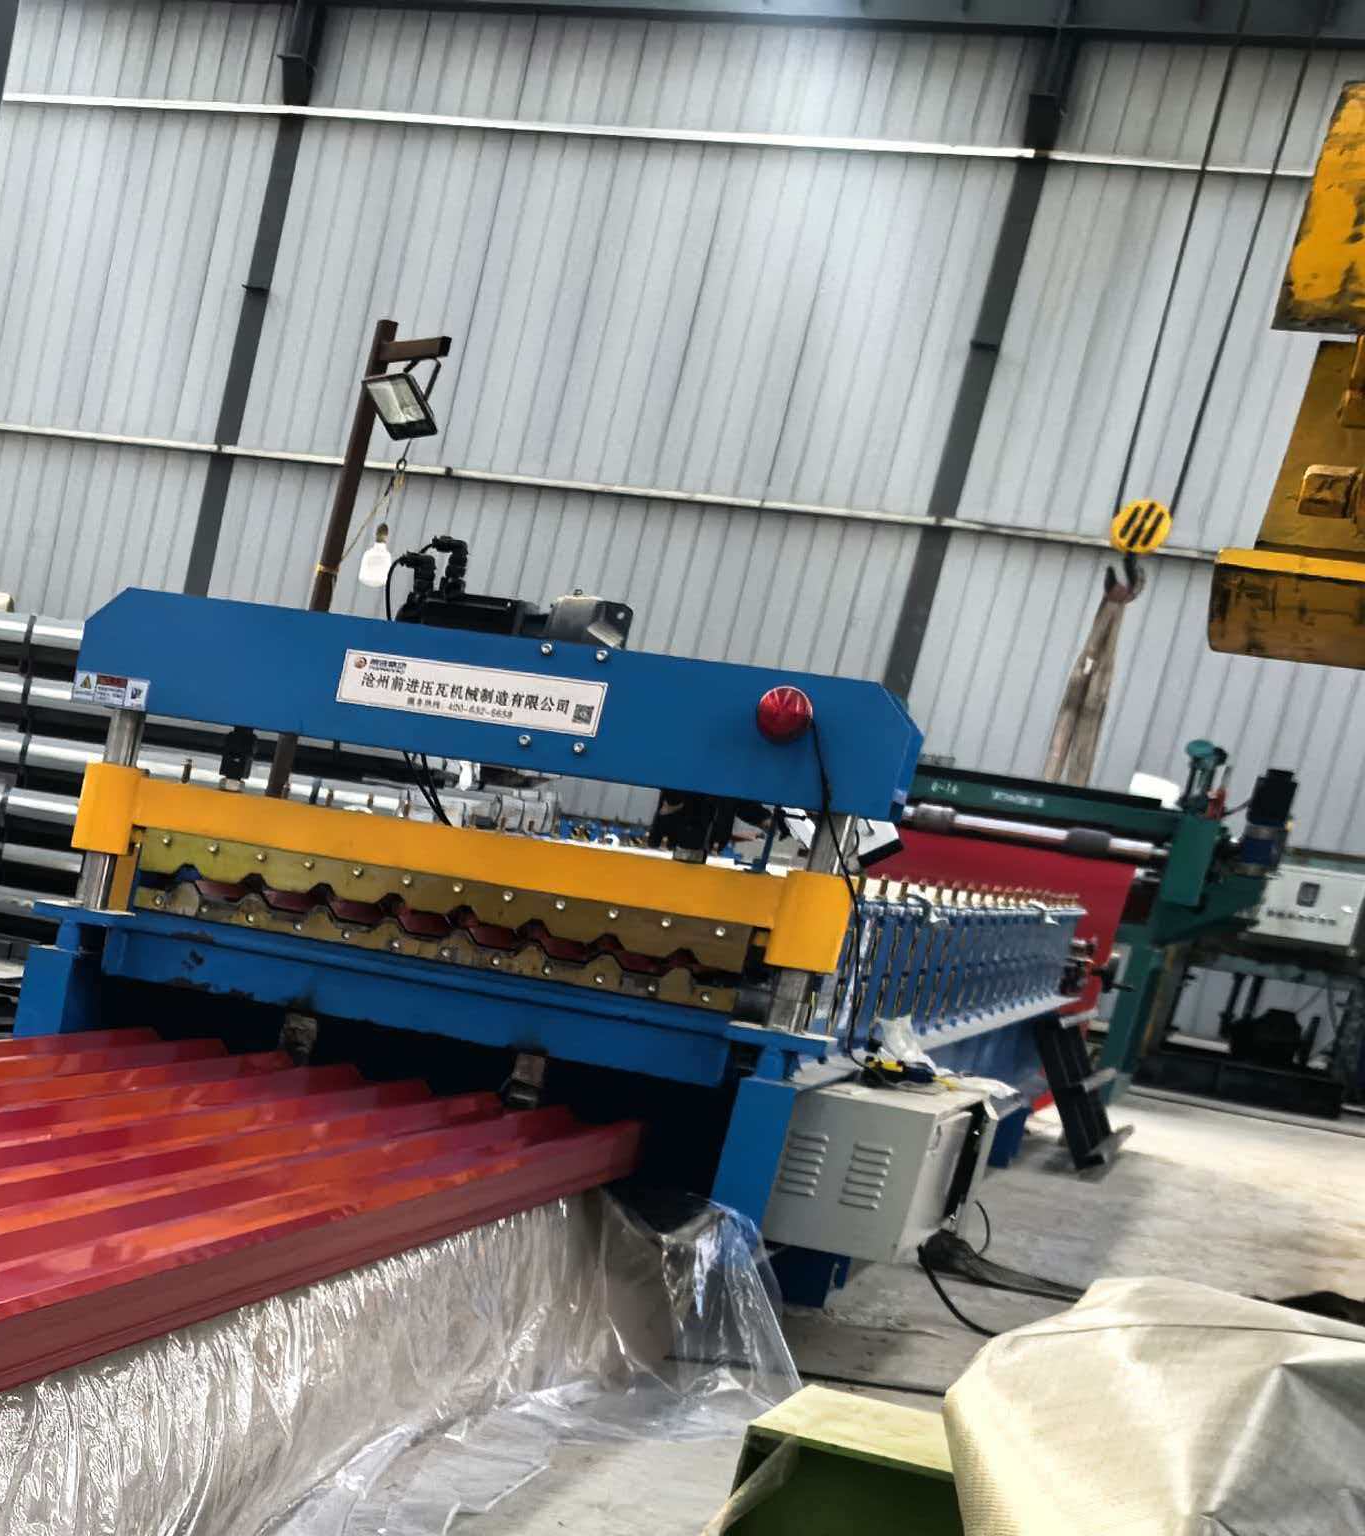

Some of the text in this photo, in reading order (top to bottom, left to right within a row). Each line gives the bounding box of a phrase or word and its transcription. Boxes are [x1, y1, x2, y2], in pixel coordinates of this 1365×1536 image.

[361, 672, 570, 715] 沧州前进压瓦机械制造有限公司
